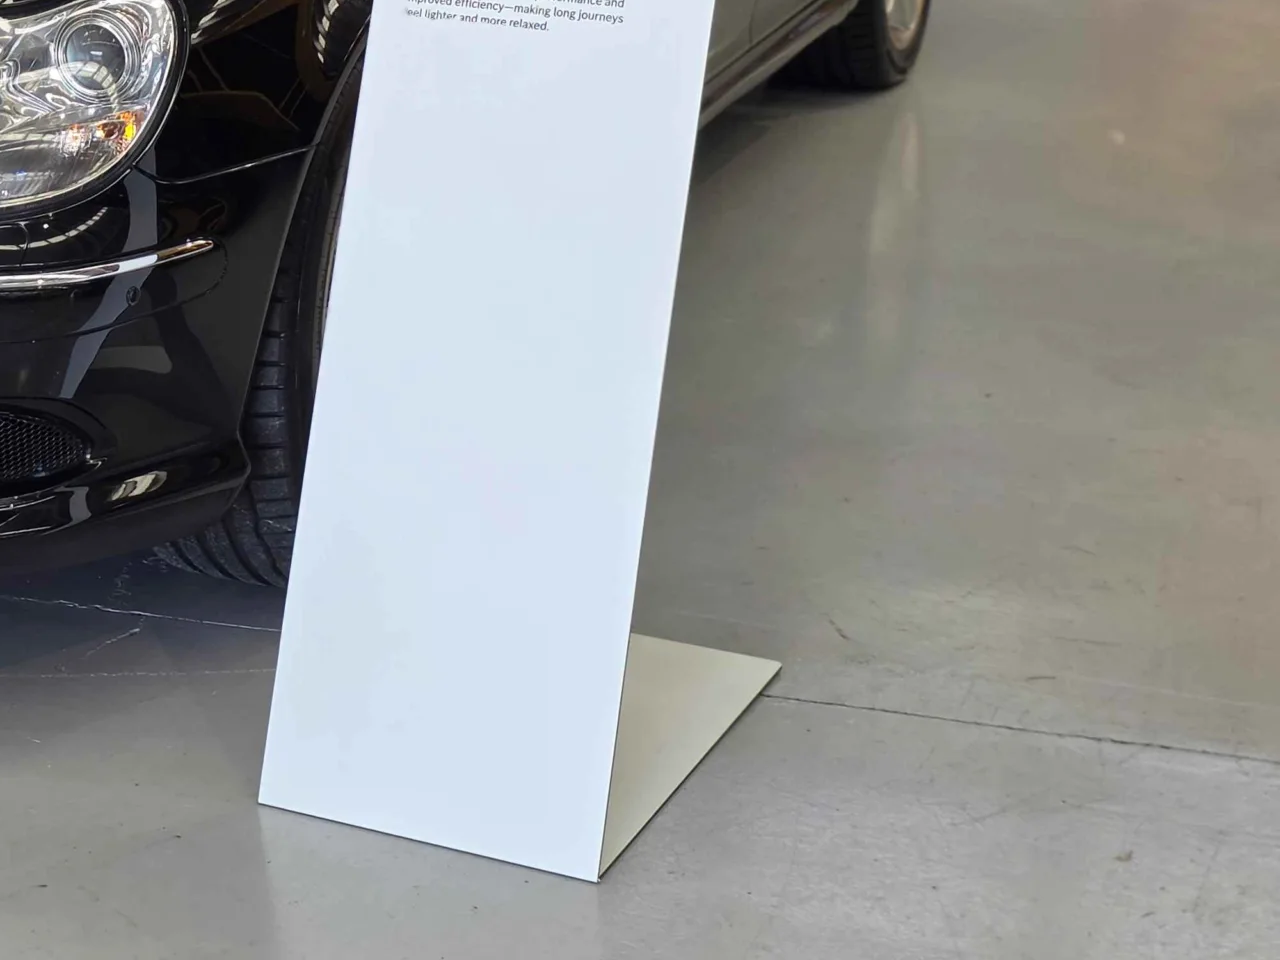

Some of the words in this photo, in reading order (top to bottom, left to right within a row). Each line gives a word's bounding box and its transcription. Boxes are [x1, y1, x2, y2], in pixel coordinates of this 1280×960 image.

[424, 9, 457, 21] lighter
[460, 14, 478, 23] and
[480, 17, 507, 26] more
[509, 19, 549, 31] relaxed.
[553, 6, 576, 20] long
[577, 9, 625, 25] journeys
